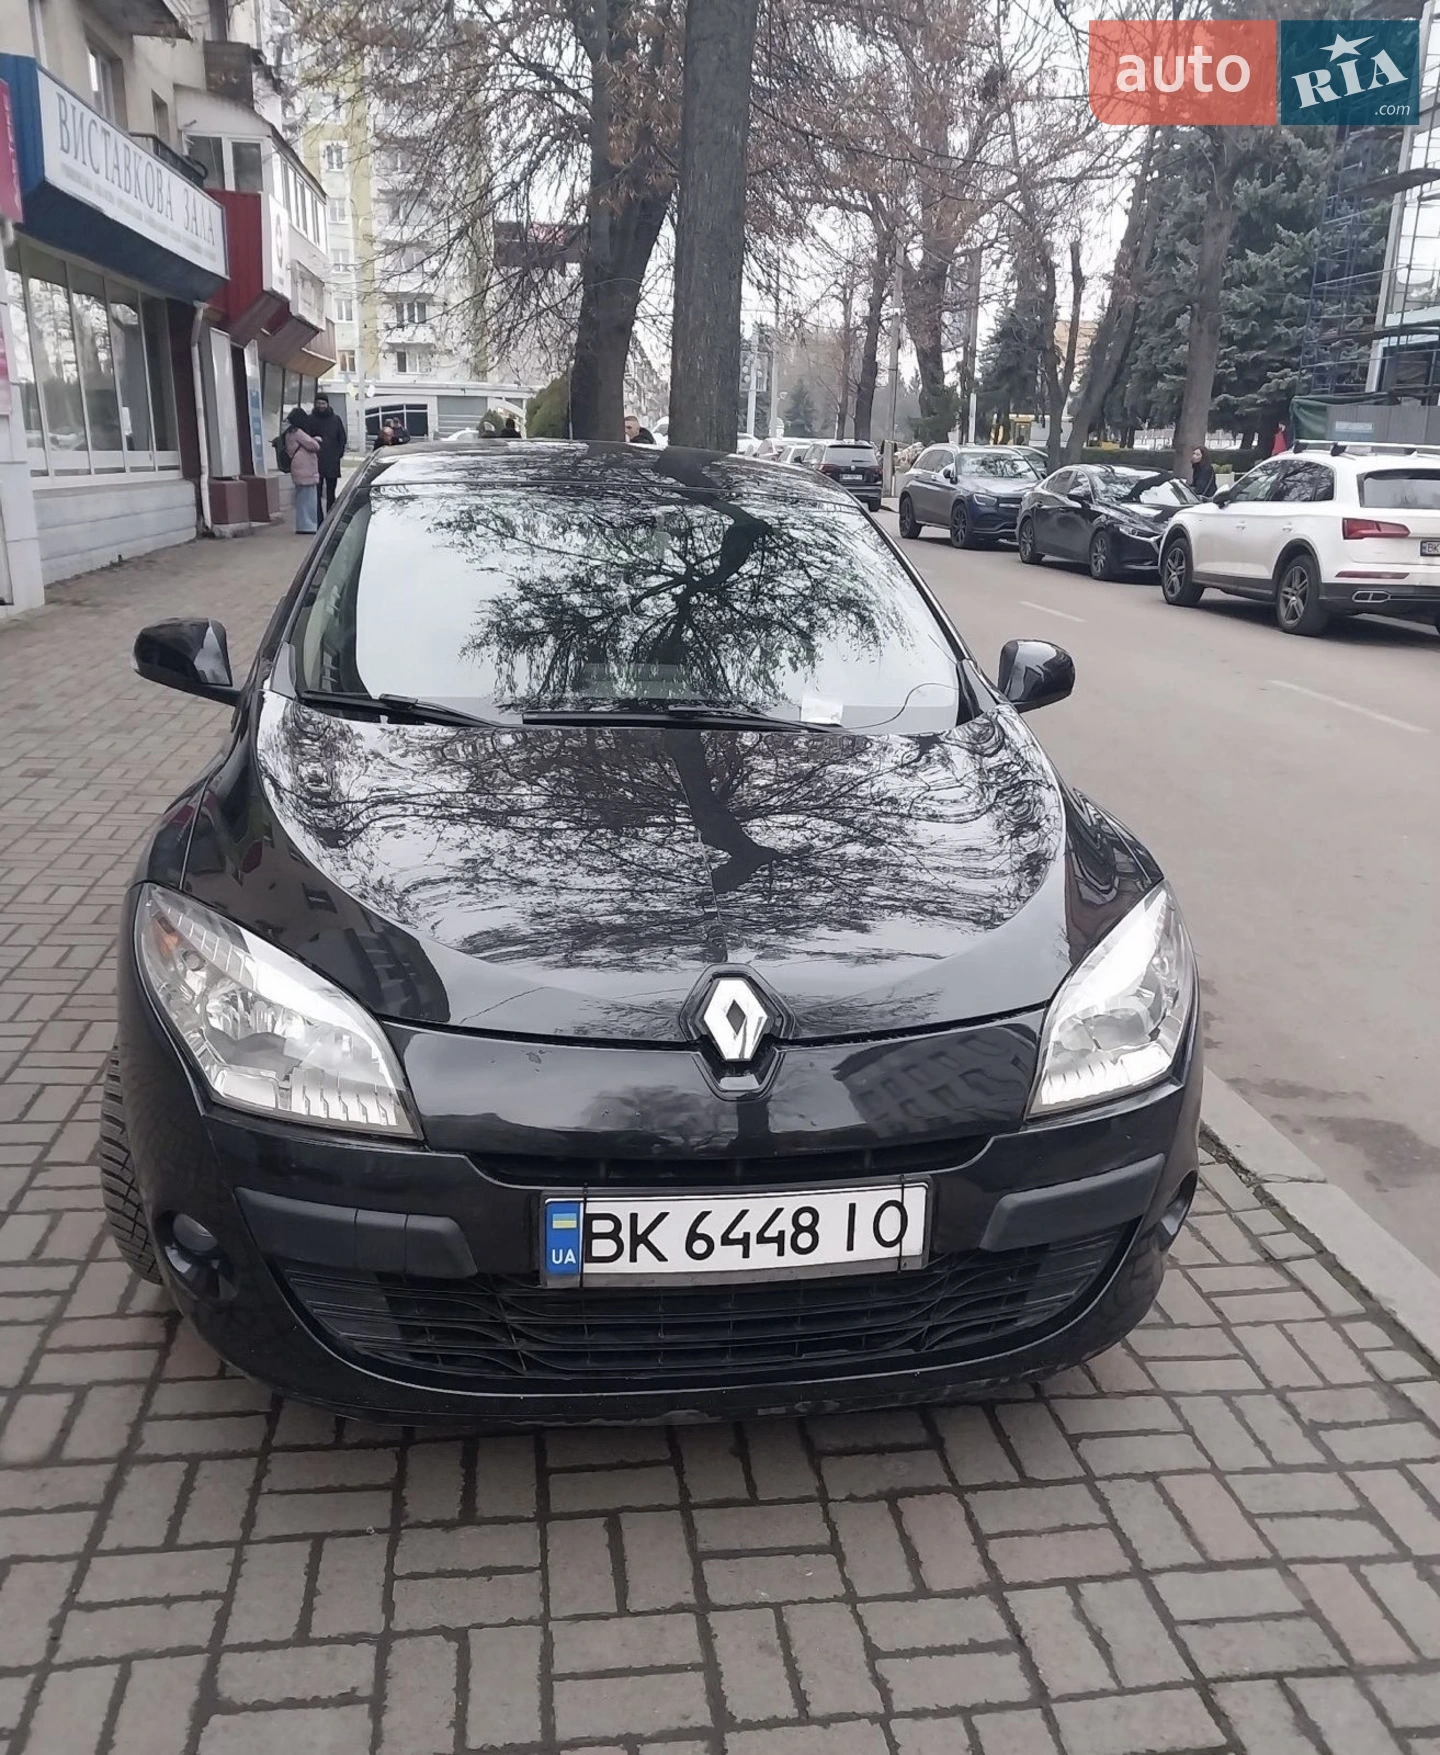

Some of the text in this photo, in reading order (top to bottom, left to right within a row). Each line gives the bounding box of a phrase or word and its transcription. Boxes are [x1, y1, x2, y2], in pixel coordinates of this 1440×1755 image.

[56, 92, 174, 222] ВИСТАВКОВА
[183, 187, 216, 247] ЗАЛА
[552, 1249, 576, 1265] UA
[584, 1200, 908, 1264] BK 6448 IO
